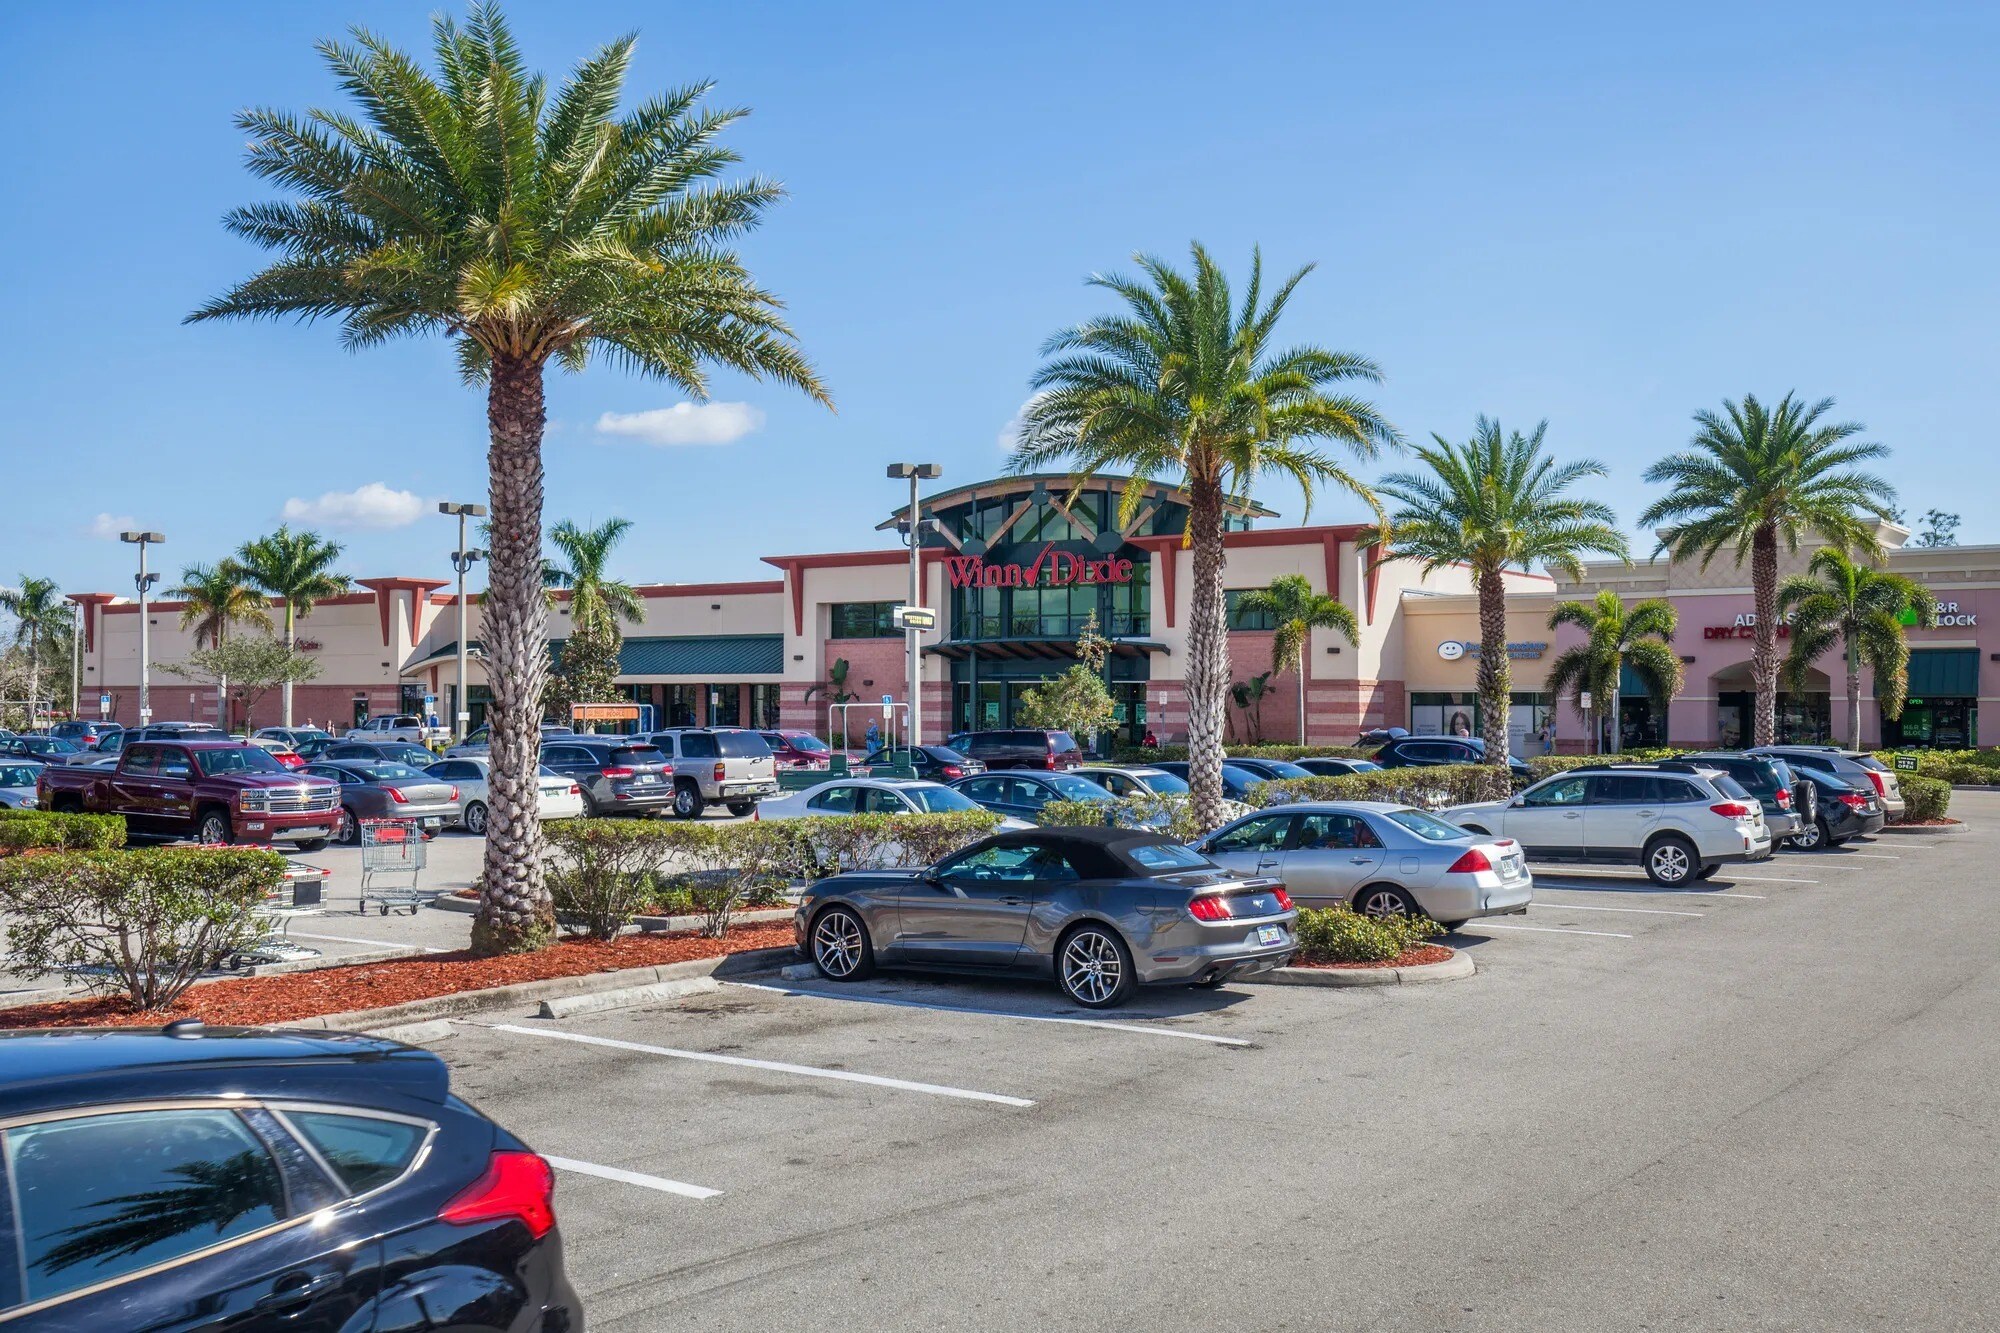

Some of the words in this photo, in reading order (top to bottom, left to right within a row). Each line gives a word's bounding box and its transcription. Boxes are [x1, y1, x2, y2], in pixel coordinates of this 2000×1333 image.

[943, 555, 1021, 588] Winn
[1050, 551, 1133, 584] Dixie
[1930, 602, 1958, 613] &R
[1734, 612, 1796, 626] ADS
[1927, 614, 1977, 626] LOCK
[1704, 626, 1733, 639] DRY
